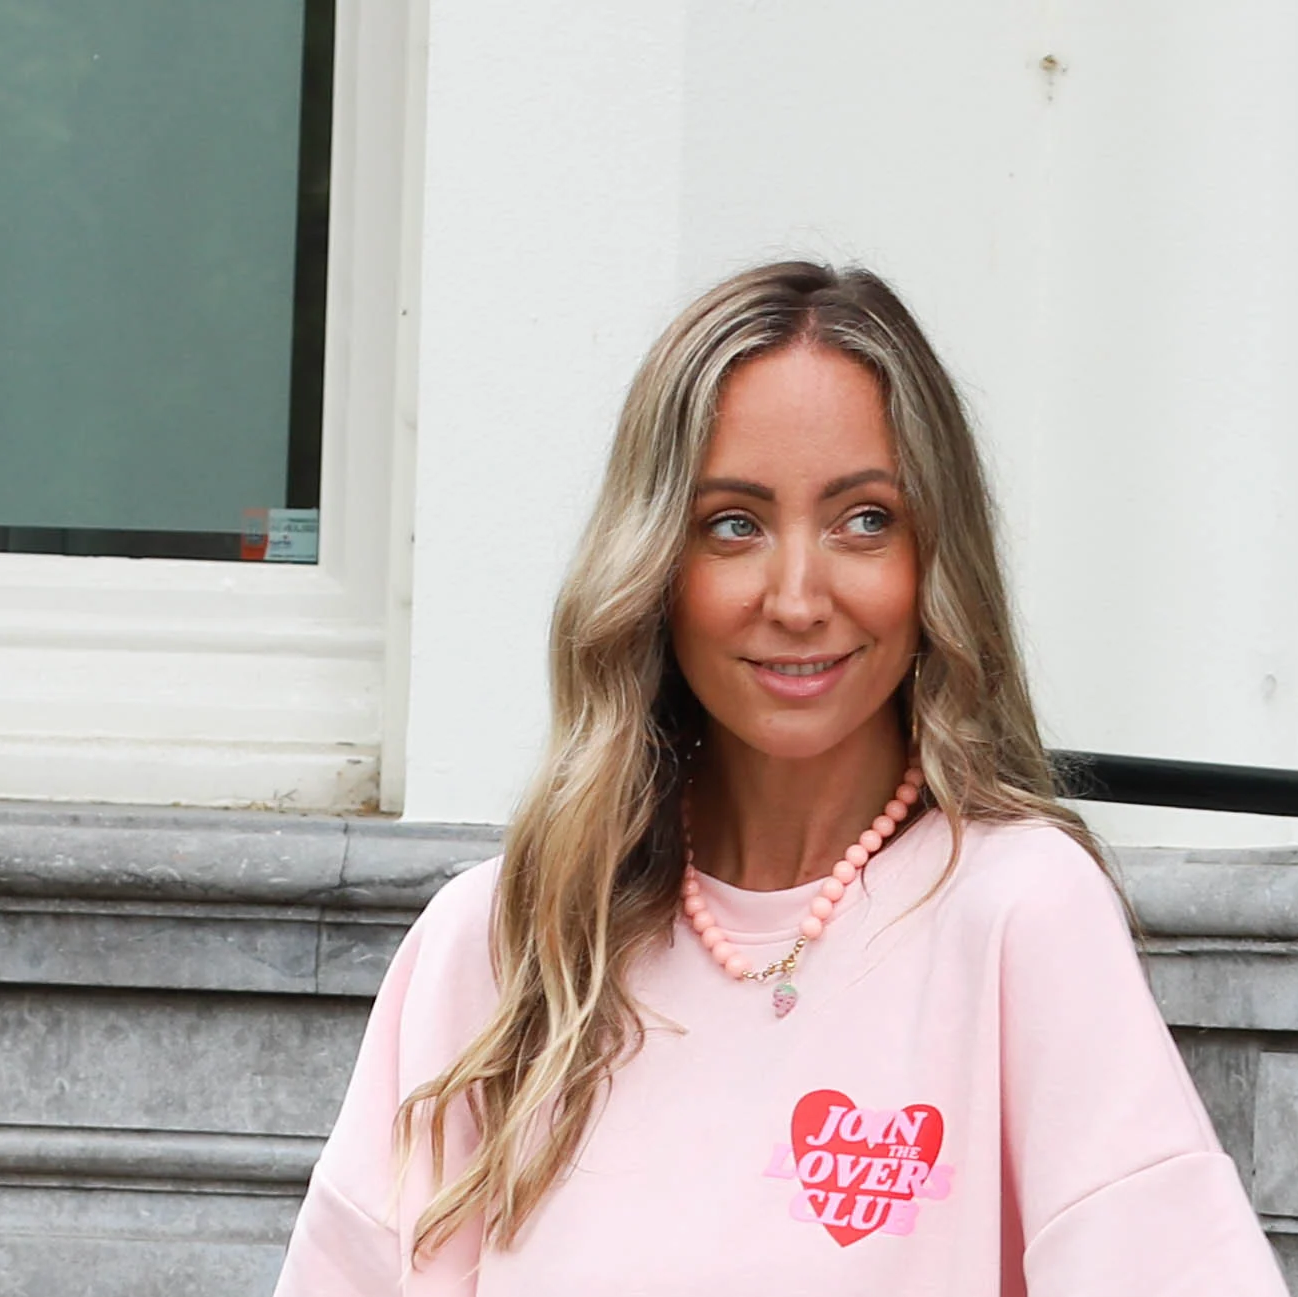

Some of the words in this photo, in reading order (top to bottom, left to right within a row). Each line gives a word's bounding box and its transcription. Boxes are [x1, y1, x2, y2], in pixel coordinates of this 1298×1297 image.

[805, 1105, 928, 1150] JOIN
[762, 1142, 956, 1201] LOVERS
[888, 1145, 922, 1160] THE
[788, 1188, 920, 1237] CLUB
